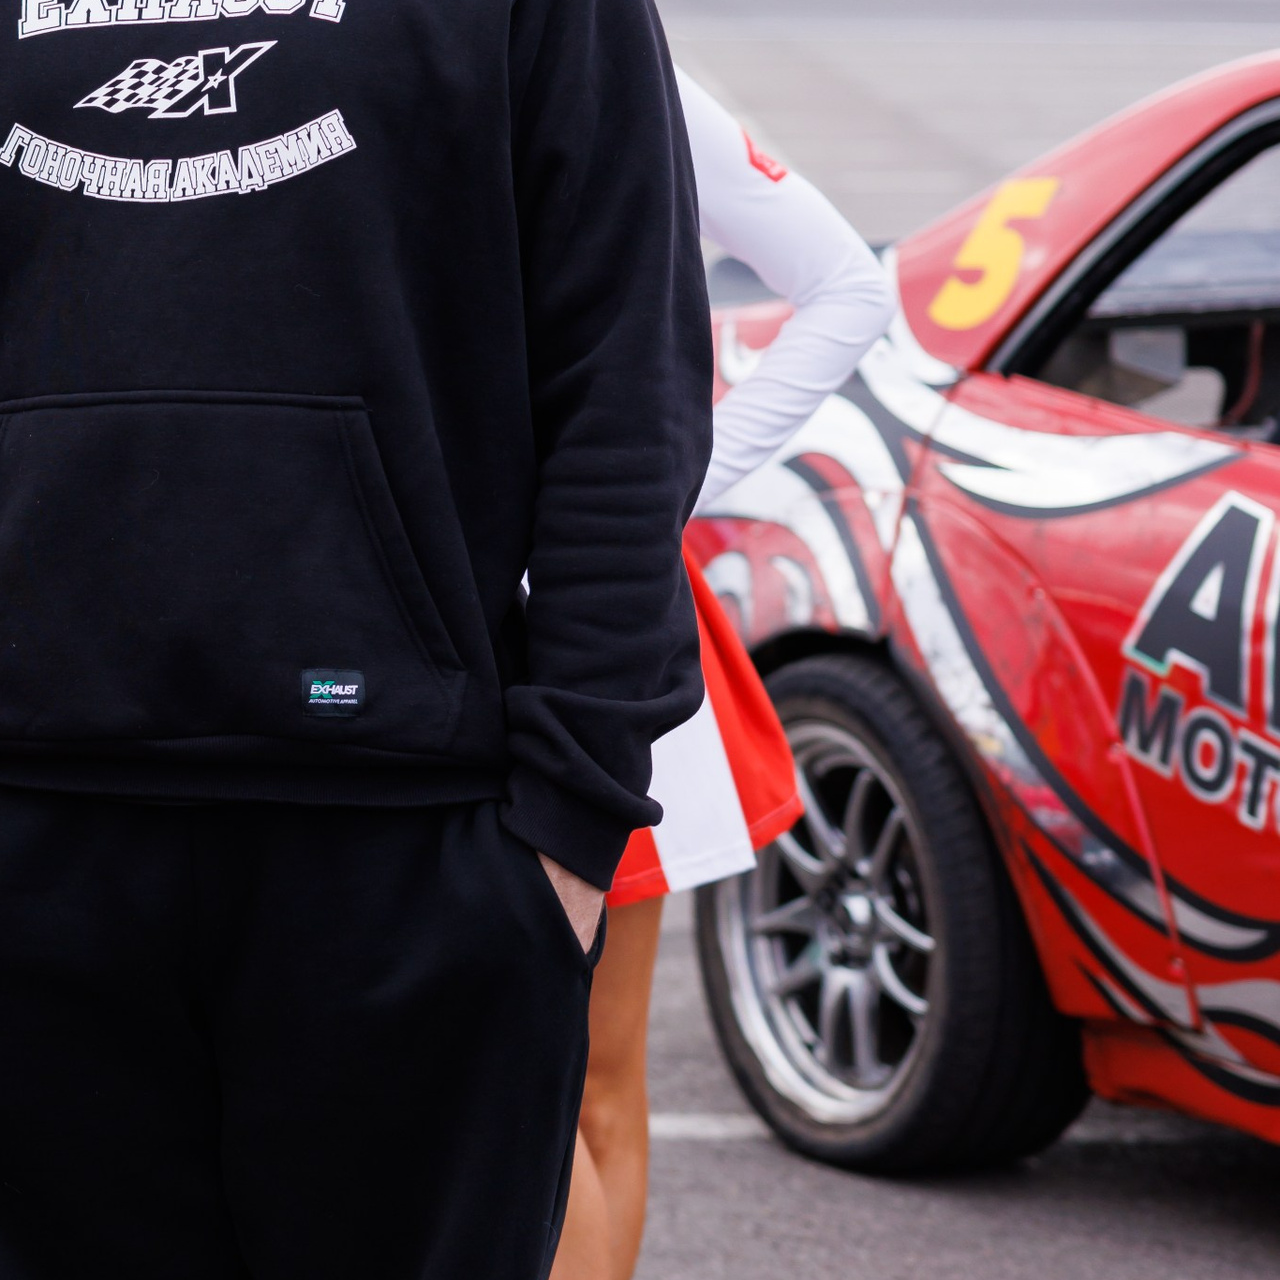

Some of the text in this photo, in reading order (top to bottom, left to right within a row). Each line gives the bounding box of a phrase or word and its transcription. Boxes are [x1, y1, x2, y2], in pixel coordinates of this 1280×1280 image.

[169, 108, 357, 202] АКАДЕМИЯ
[929, 177, 1059, 330] 5
[310, 683, 359, 696] EXHAUST
[1119, 667, 1280, 831] MOT
